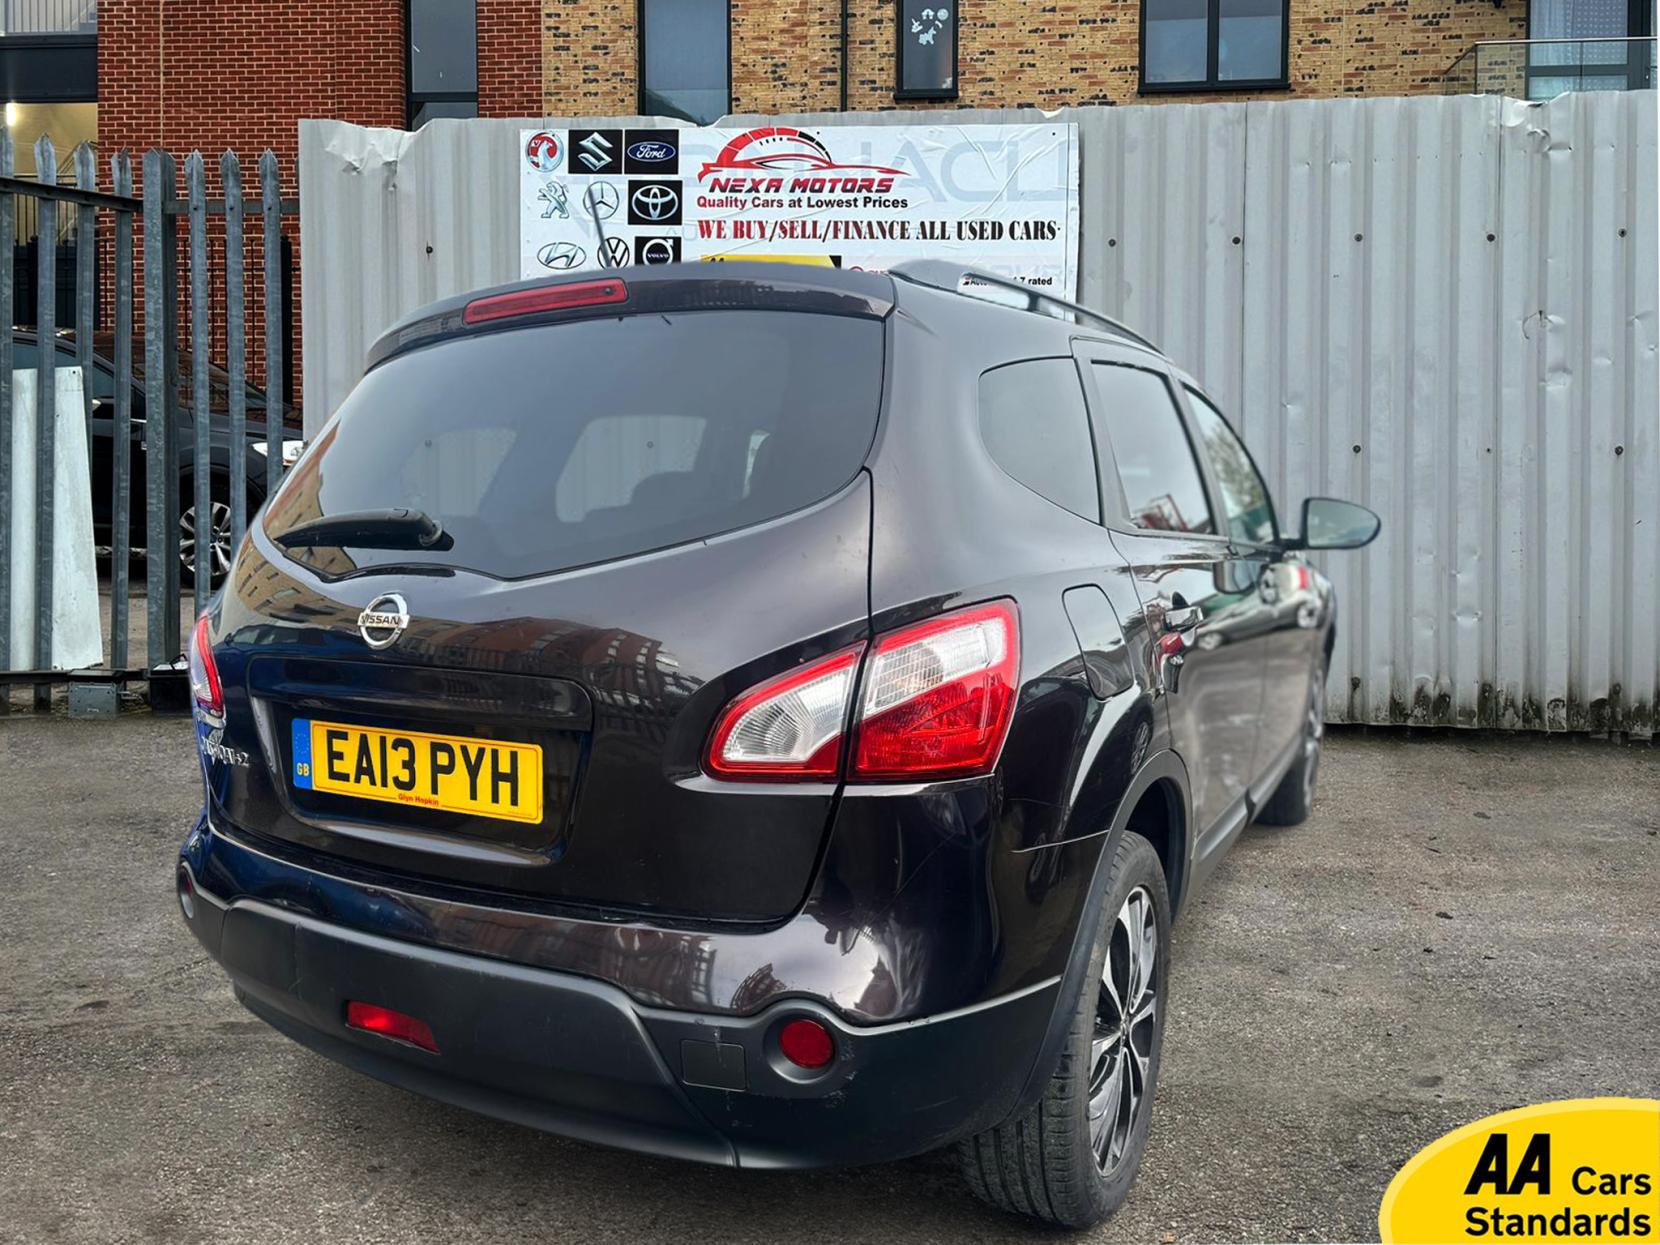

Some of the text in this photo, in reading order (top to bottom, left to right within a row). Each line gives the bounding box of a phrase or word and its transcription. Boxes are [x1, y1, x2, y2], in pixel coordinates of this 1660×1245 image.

[635, 144, 666, 159] Ford
[709, 178, 895, 193] NEXA MOTORS
[697, 196, 908, 210] Quality Cars at Lowest Prices
[697, 220, 727, 239] WE
[915, 220, 951, 240] ALL
[956, 220, 1003, 240] USED
[1009, 220, 1057, 240] CARS
[1028, 277, 1053, 285] rated
[361, 613, 401, 625] NISSAN
[296, 762, 310, 777] GB
[325, 729, 417, 792] EA13
[430, 741, 519, 807] PYH
[398, 793, 414, 803] Glyn
